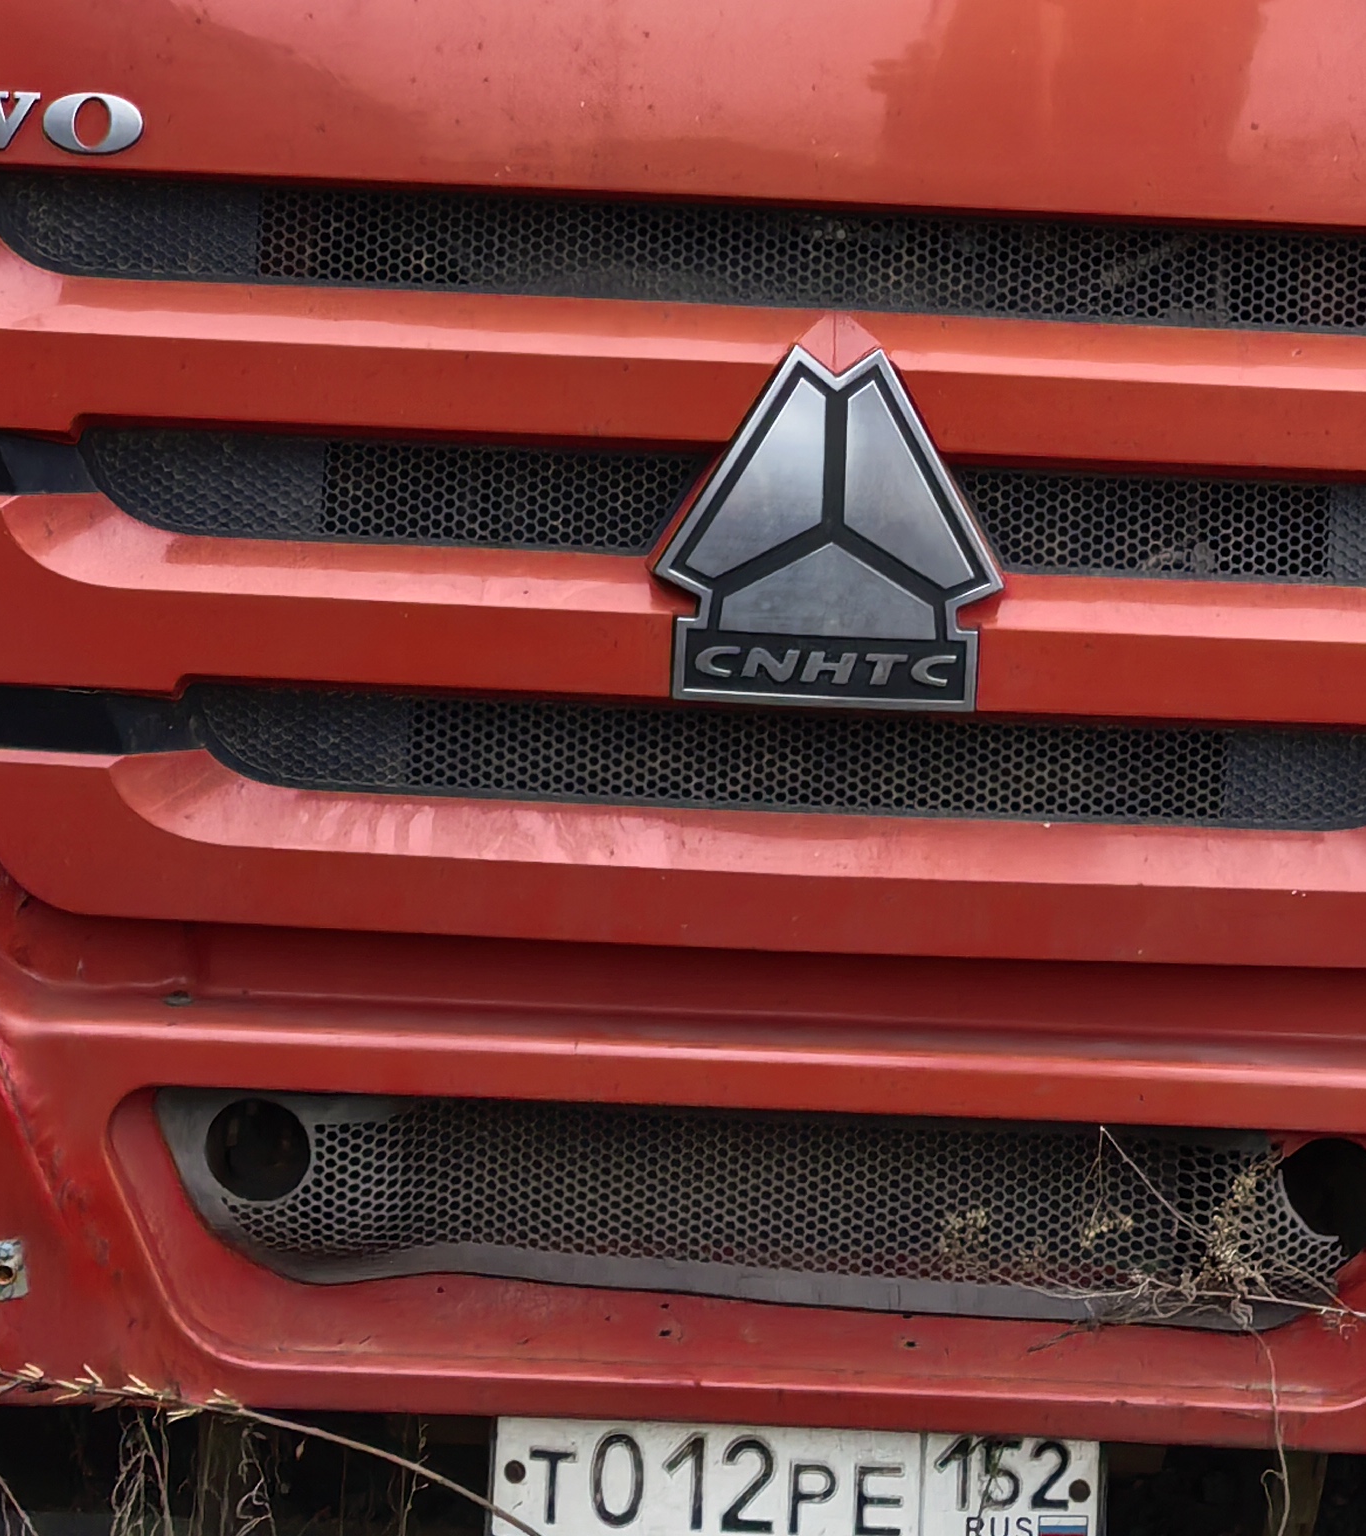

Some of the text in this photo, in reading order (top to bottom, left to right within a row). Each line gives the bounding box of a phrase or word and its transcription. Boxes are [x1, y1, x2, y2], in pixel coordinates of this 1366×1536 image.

[695, 645, 957, 687] CNHTC
[935, 1435, 1070, 1511] 152
[966, 1516, 1033, 1536] RUS
